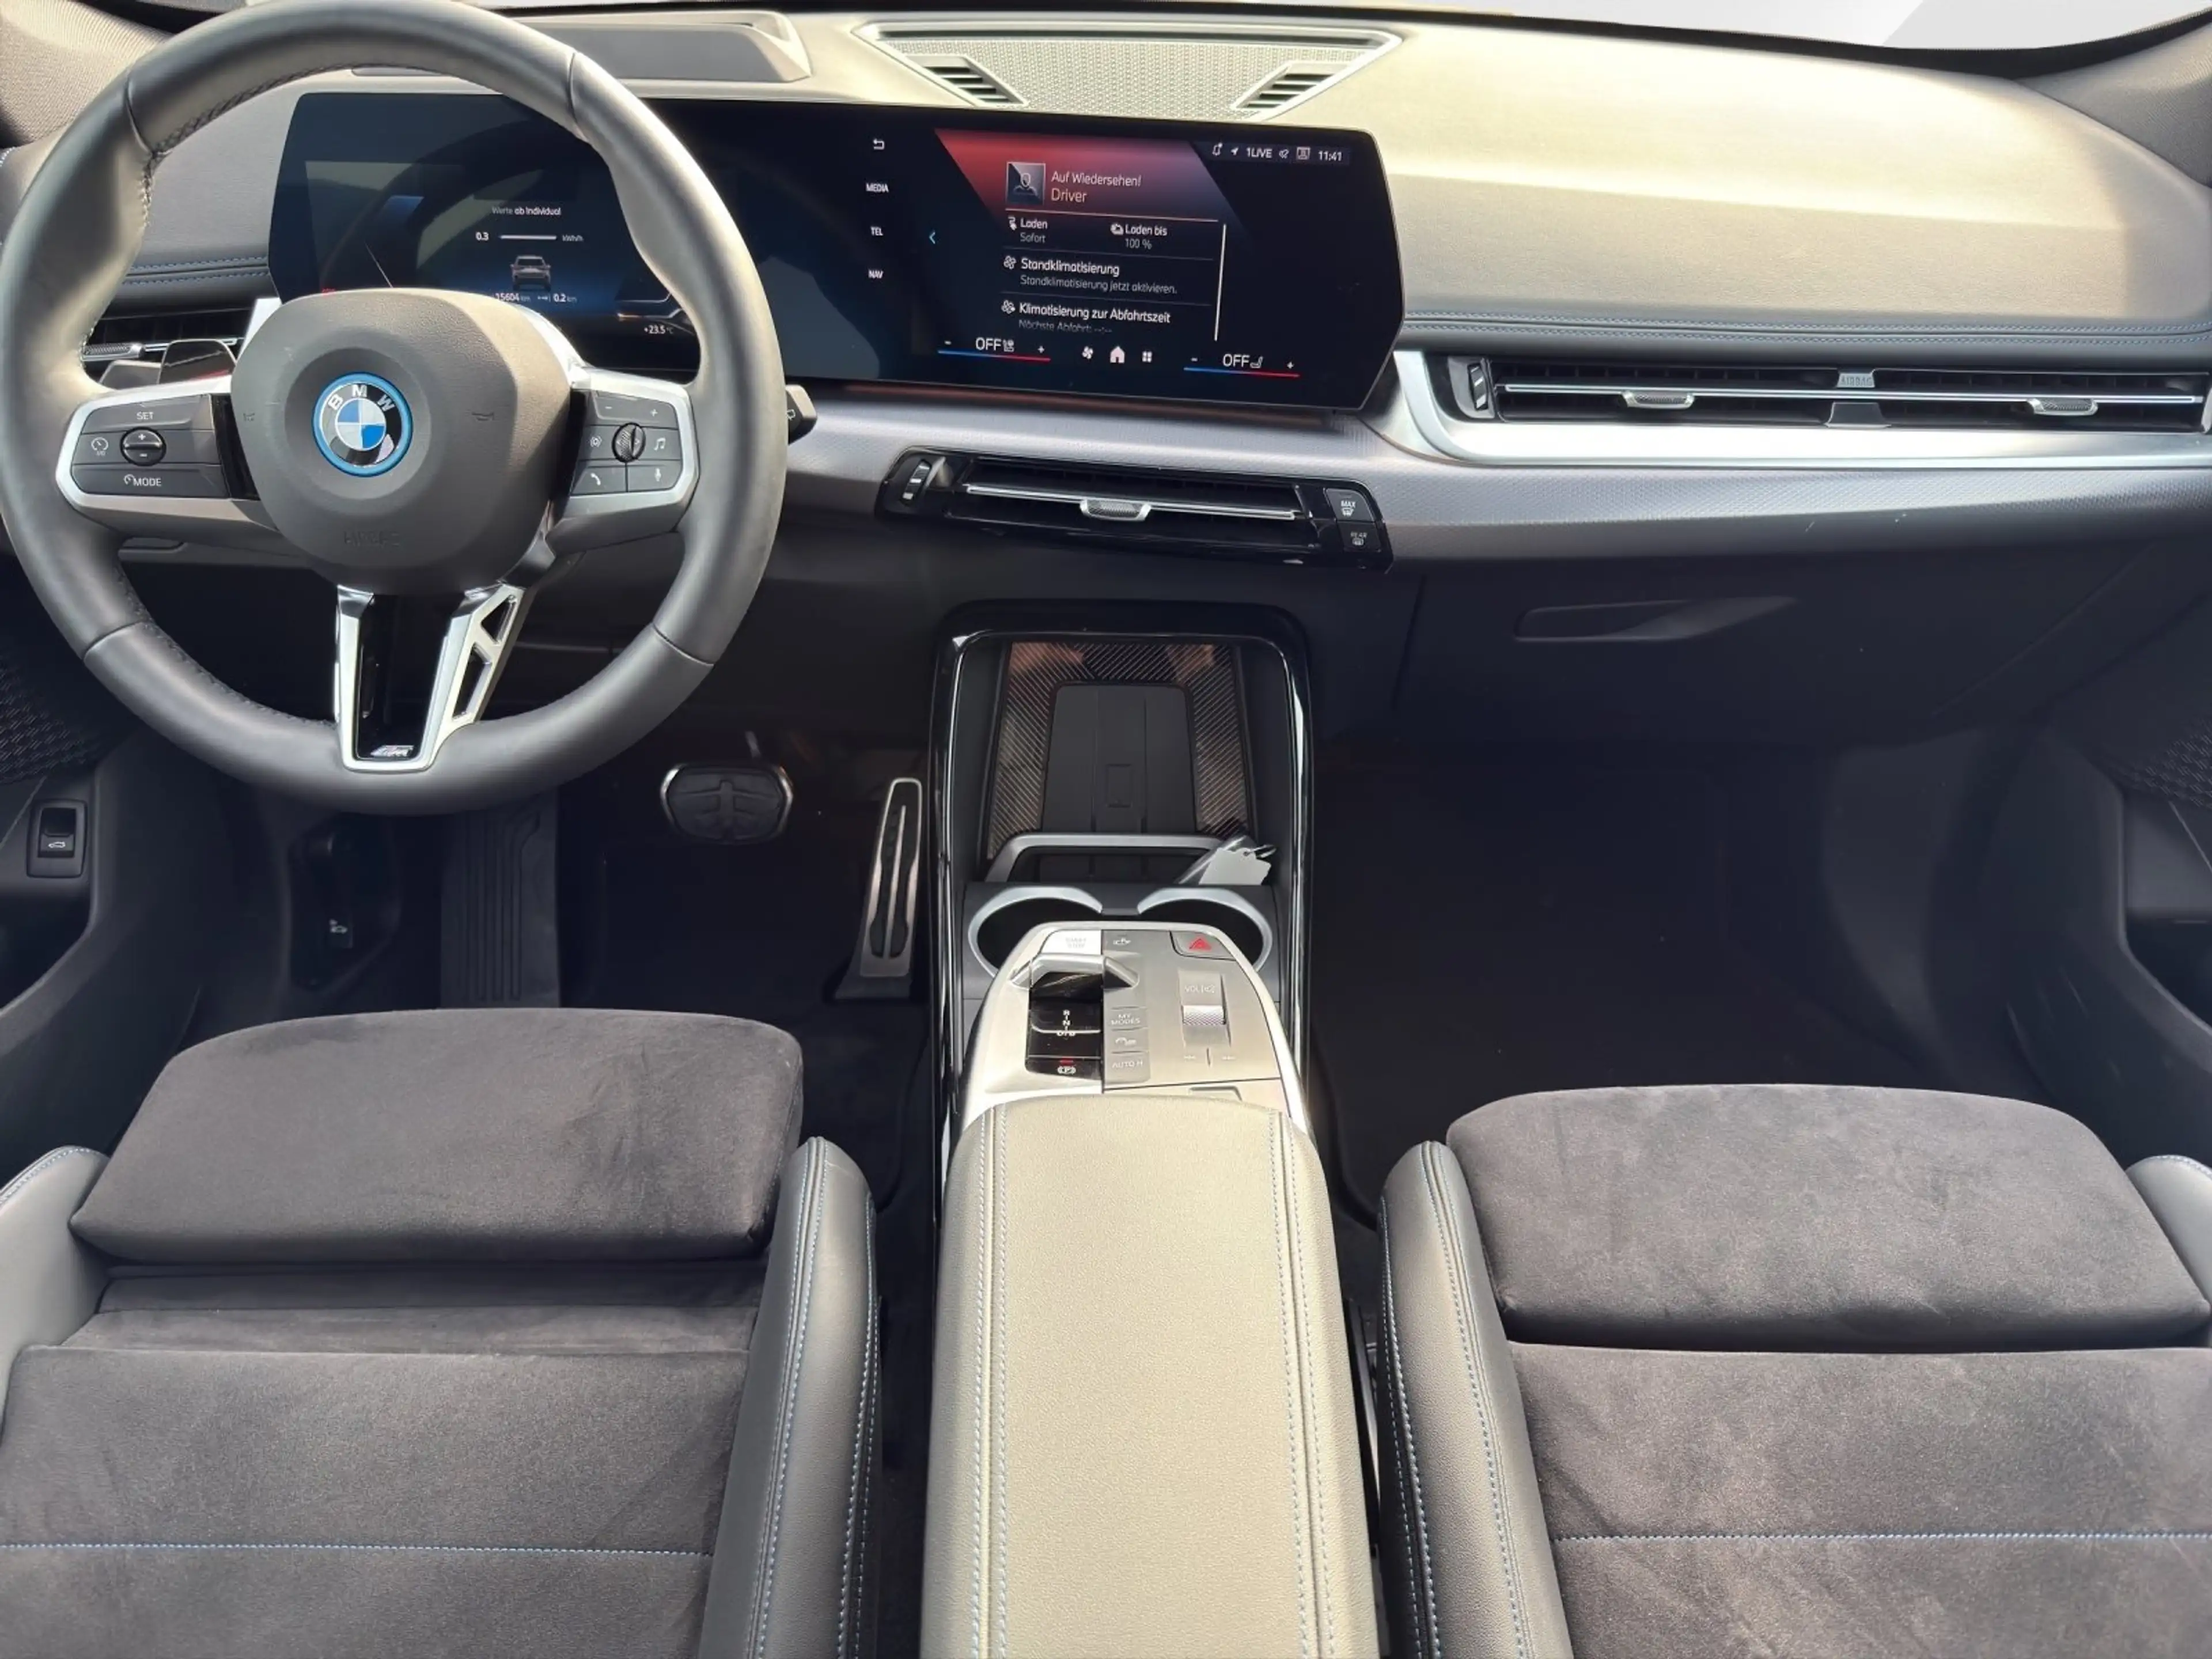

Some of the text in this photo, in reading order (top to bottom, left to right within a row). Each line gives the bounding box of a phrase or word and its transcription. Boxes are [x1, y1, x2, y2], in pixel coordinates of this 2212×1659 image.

[1317, 150, 1342, 161] 11:41
[1051, 171, 1142, 187] Auf Wiedersehen!
[865, 183, 889, 193] MEDIA
[1051, 188, 1088, 202] Driver
[1020, 218, 1048, 229] Laden
[870, 226, 884, 236] TEL
[1125, 224, 1168, 237] Laden bis
[475, 232, 489, 241] 0.3
[1020, 232, 1046, 243] Sofort
[1126, 238, 1153, 250] 100 %
[1021, 257, 1120, 277] Standklimatisierung
[868, 269, 884, 279] NAV
[1020, 274, 1178, 294] Standklimatisierung jetzt aktivieren.
[552, 293, 566, 302] 0.2
[1019, 302, 1171, 323] Klimatisierung zur Abfahrtszeit
[975, 338, 1002, 351] OFF
[1223, 353, 1250, 368] OFF
[327, 384, 395, 412] BMW
[136, 411, 154, 420] SET
[133, 478, 162, 487] MODE
